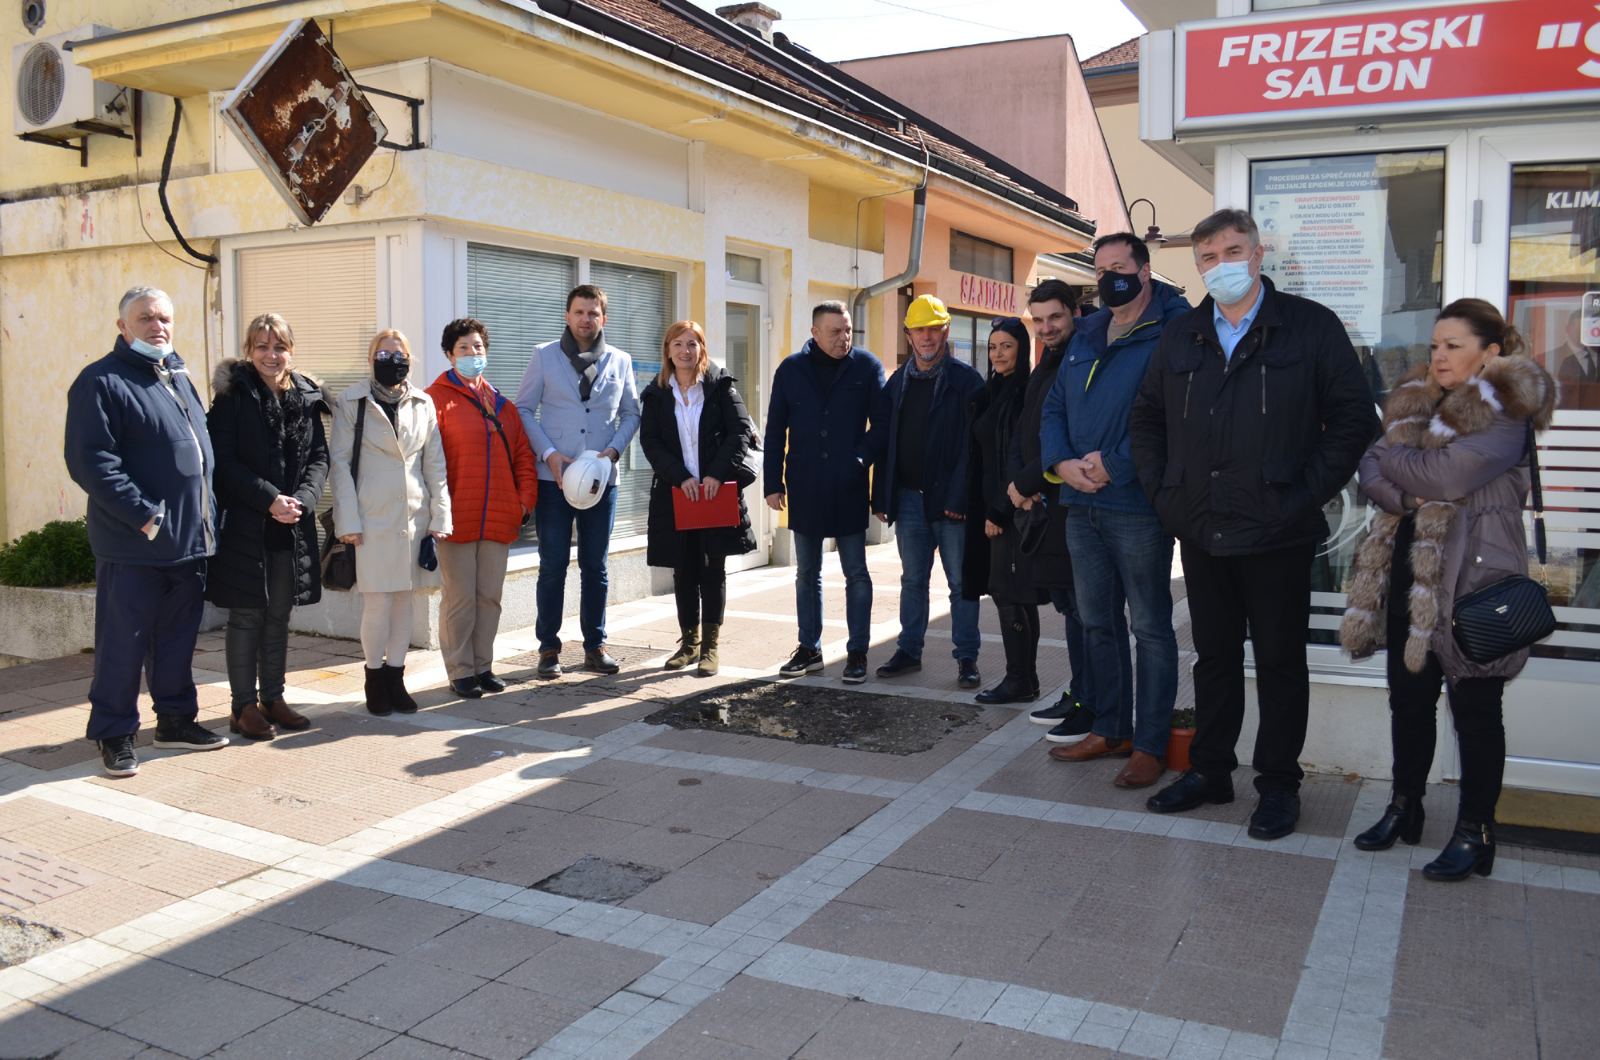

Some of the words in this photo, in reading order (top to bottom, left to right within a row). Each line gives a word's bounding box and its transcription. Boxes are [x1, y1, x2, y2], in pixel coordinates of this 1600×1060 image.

[1218, 14, 1484, 68] FRIZERSKI
[1263, 57, 1432, 100] SALON
[1546, 191, 1600, 209] KLIM
